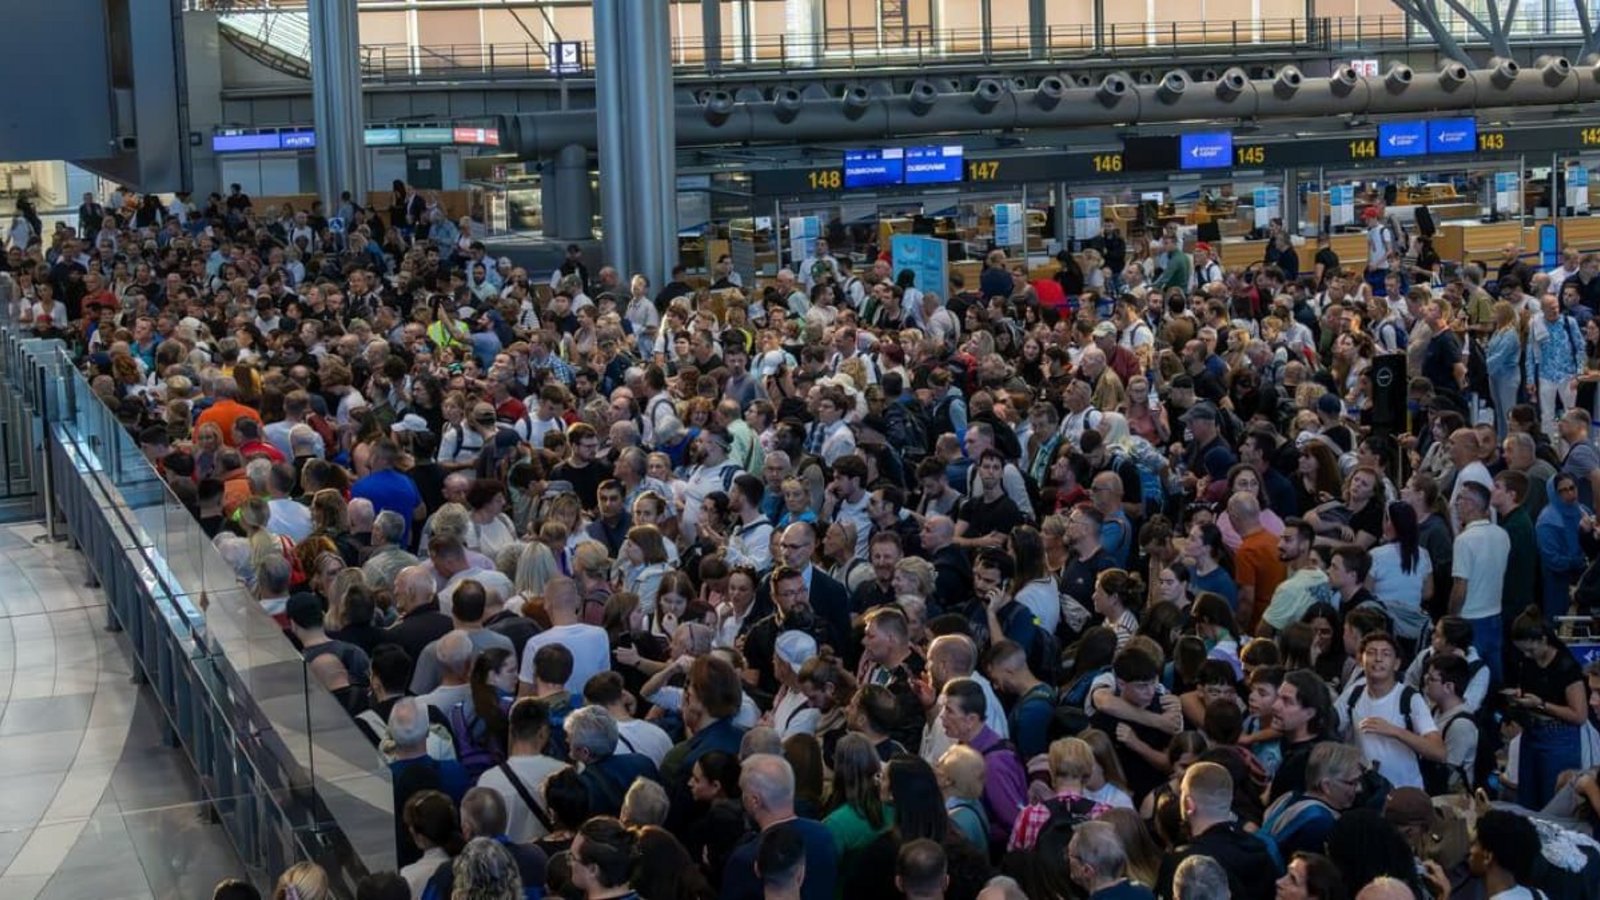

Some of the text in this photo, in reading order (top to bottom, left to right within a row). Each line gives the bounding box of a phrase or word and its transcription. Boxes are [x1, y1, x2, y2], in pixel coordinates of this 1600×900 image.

[1350, 141, 1376, 158] 144
[1479, 133, 1505, 149] 143
[1093, 155, 1122, 171] 146
[1237, 146, 1265, 163] 145
[969, 161, 999, 180] 147
[809, 171, 841, 189] 148
